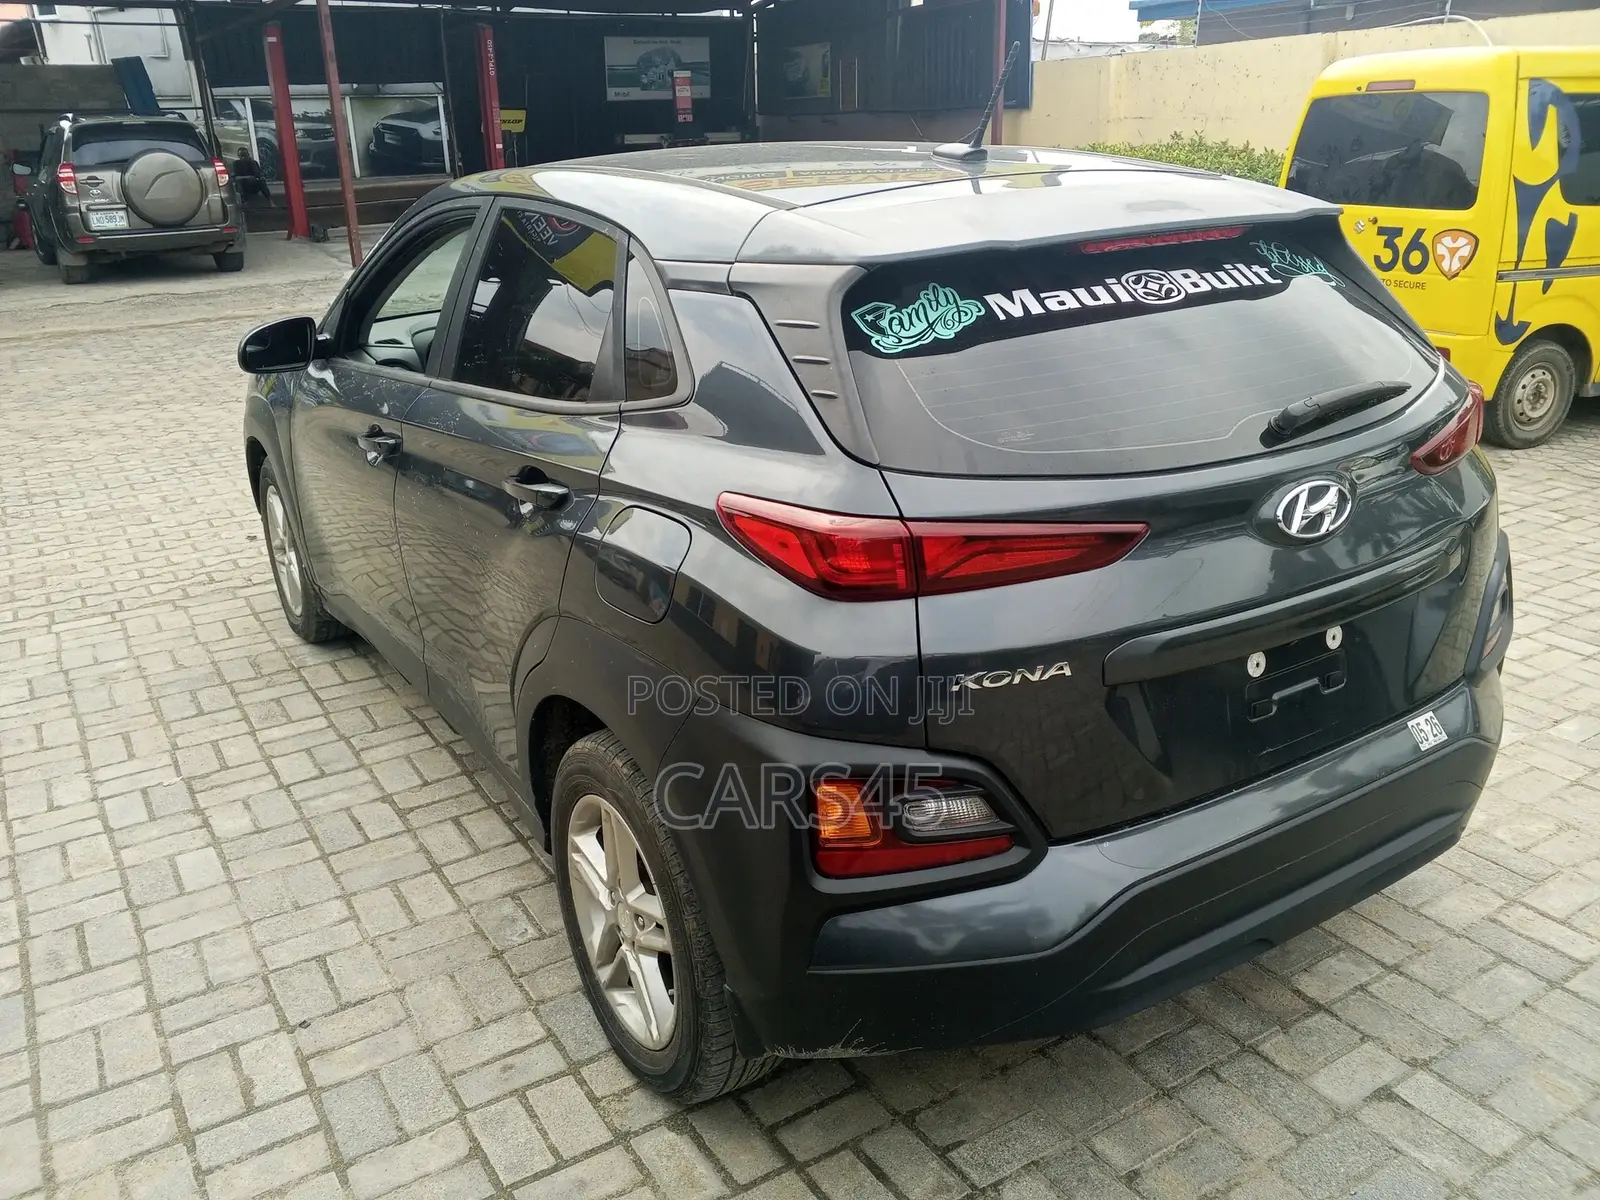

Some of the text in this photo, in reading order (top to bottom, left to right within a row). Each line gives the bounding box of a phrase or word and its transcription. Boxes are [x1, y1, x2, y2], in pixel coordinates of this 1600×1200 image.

[982, 263, 1283, 321] Maui Built
[1393, 279, 1427, 290] SECURE
[851, 283, 985, 353] Family
[950, 661, 1073, 692] KONA
[1410, 721, 1430, 745] 05
[1424, 715, 1444, 738] 26
